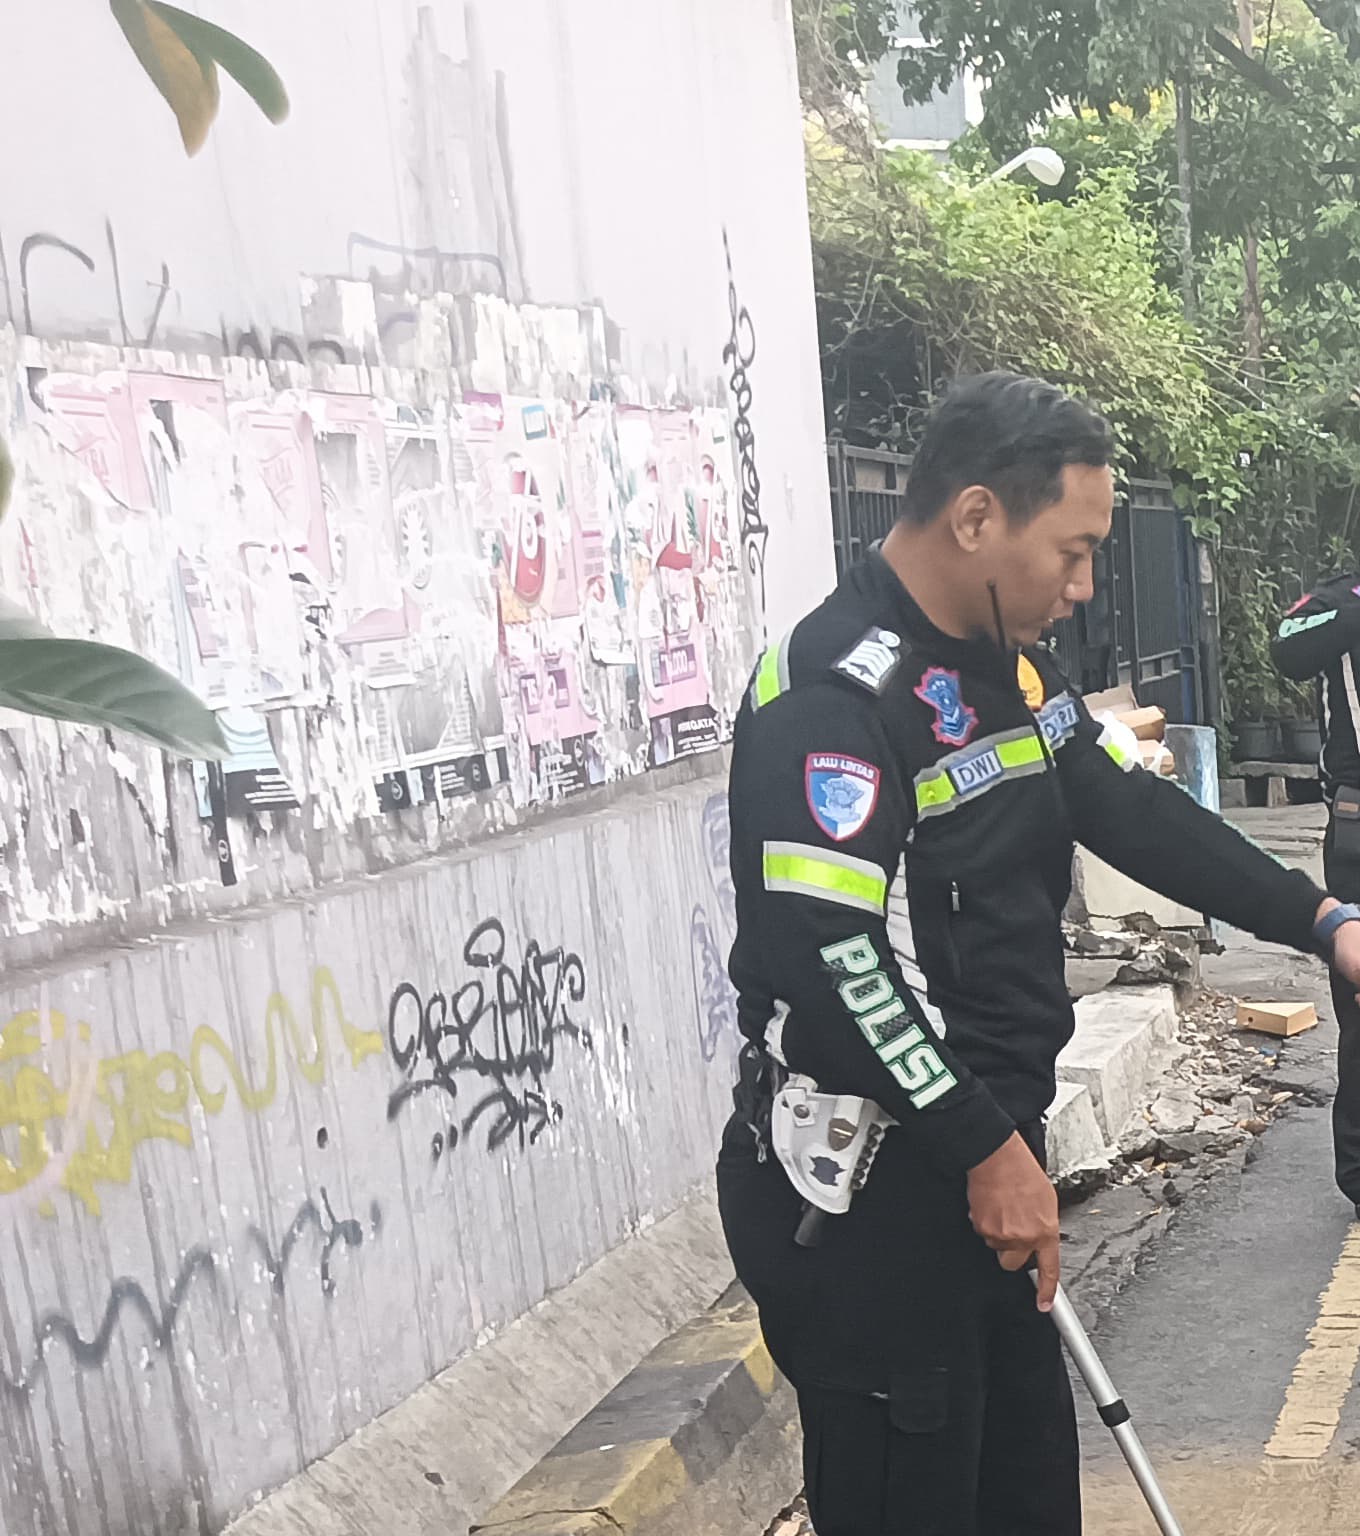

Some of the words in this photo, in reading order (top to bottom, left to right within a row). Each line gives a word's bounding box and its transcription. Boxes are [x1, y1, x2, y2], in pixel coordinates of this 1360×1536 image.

[812, 757, 839, 769] LALU
[840, 759, 875, 780] LINTAS
[957, 754, 996, 786] DWI
[819, 933, 958, 1110] POLISI
